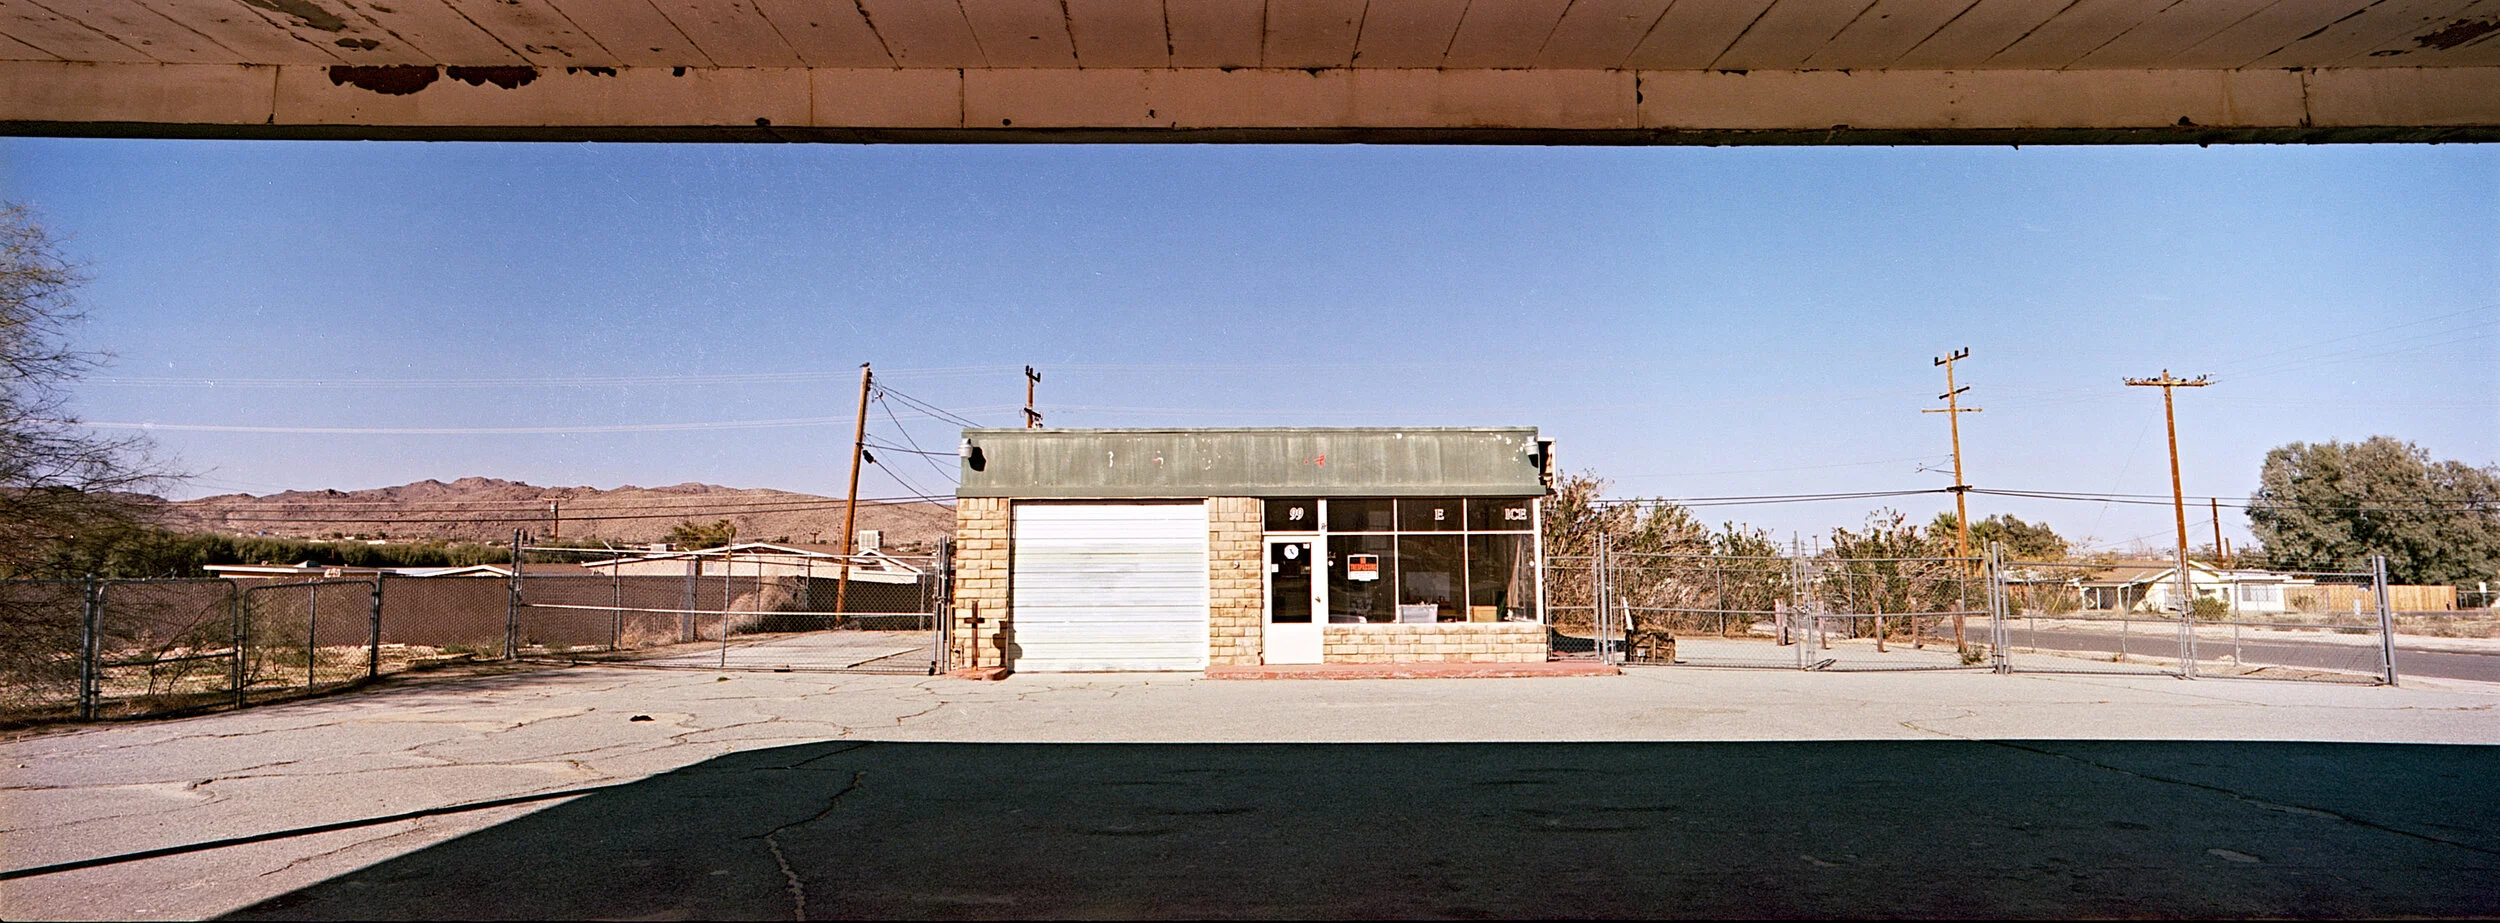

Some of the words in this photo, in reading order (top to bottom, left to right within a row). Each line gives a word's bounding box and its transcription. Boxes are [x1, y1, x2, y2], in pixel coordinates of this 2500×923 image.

[1289, 507, 1304, 520] 99
[1434, 508, 1445, 521] E
[1504, 508, 1527, 521] ICE
